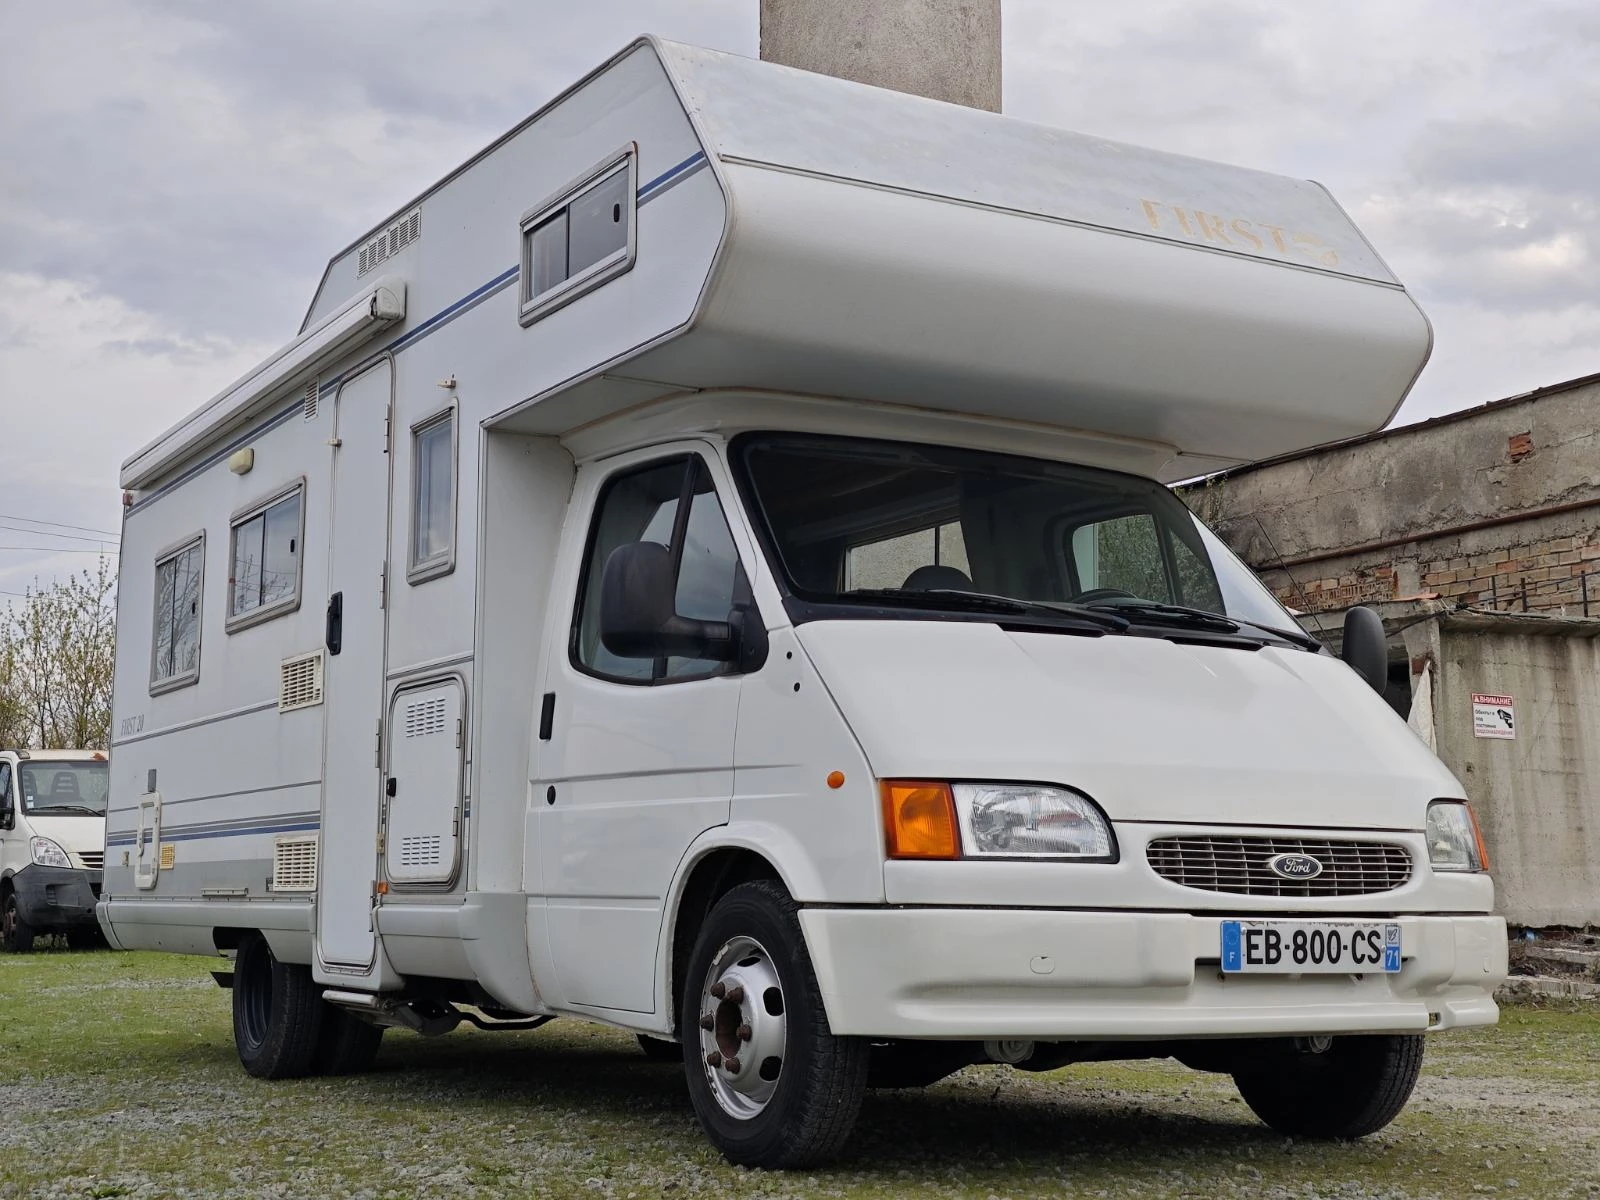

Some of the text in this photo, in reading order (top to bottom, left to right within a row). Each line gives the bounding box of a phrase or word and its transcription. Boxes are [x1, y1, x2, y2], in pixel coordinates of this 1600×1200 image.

[1139, 197, 1287, 254] FIRST
[1480, 695, 1512, 706] ВНИМАНИЕ
[121, 717, 136, 737] FIRST
[1284, 858, 1311, 873] Ford
[1229, 951, 1235, 963] F
[1386, 950, 1399, 967] 71
